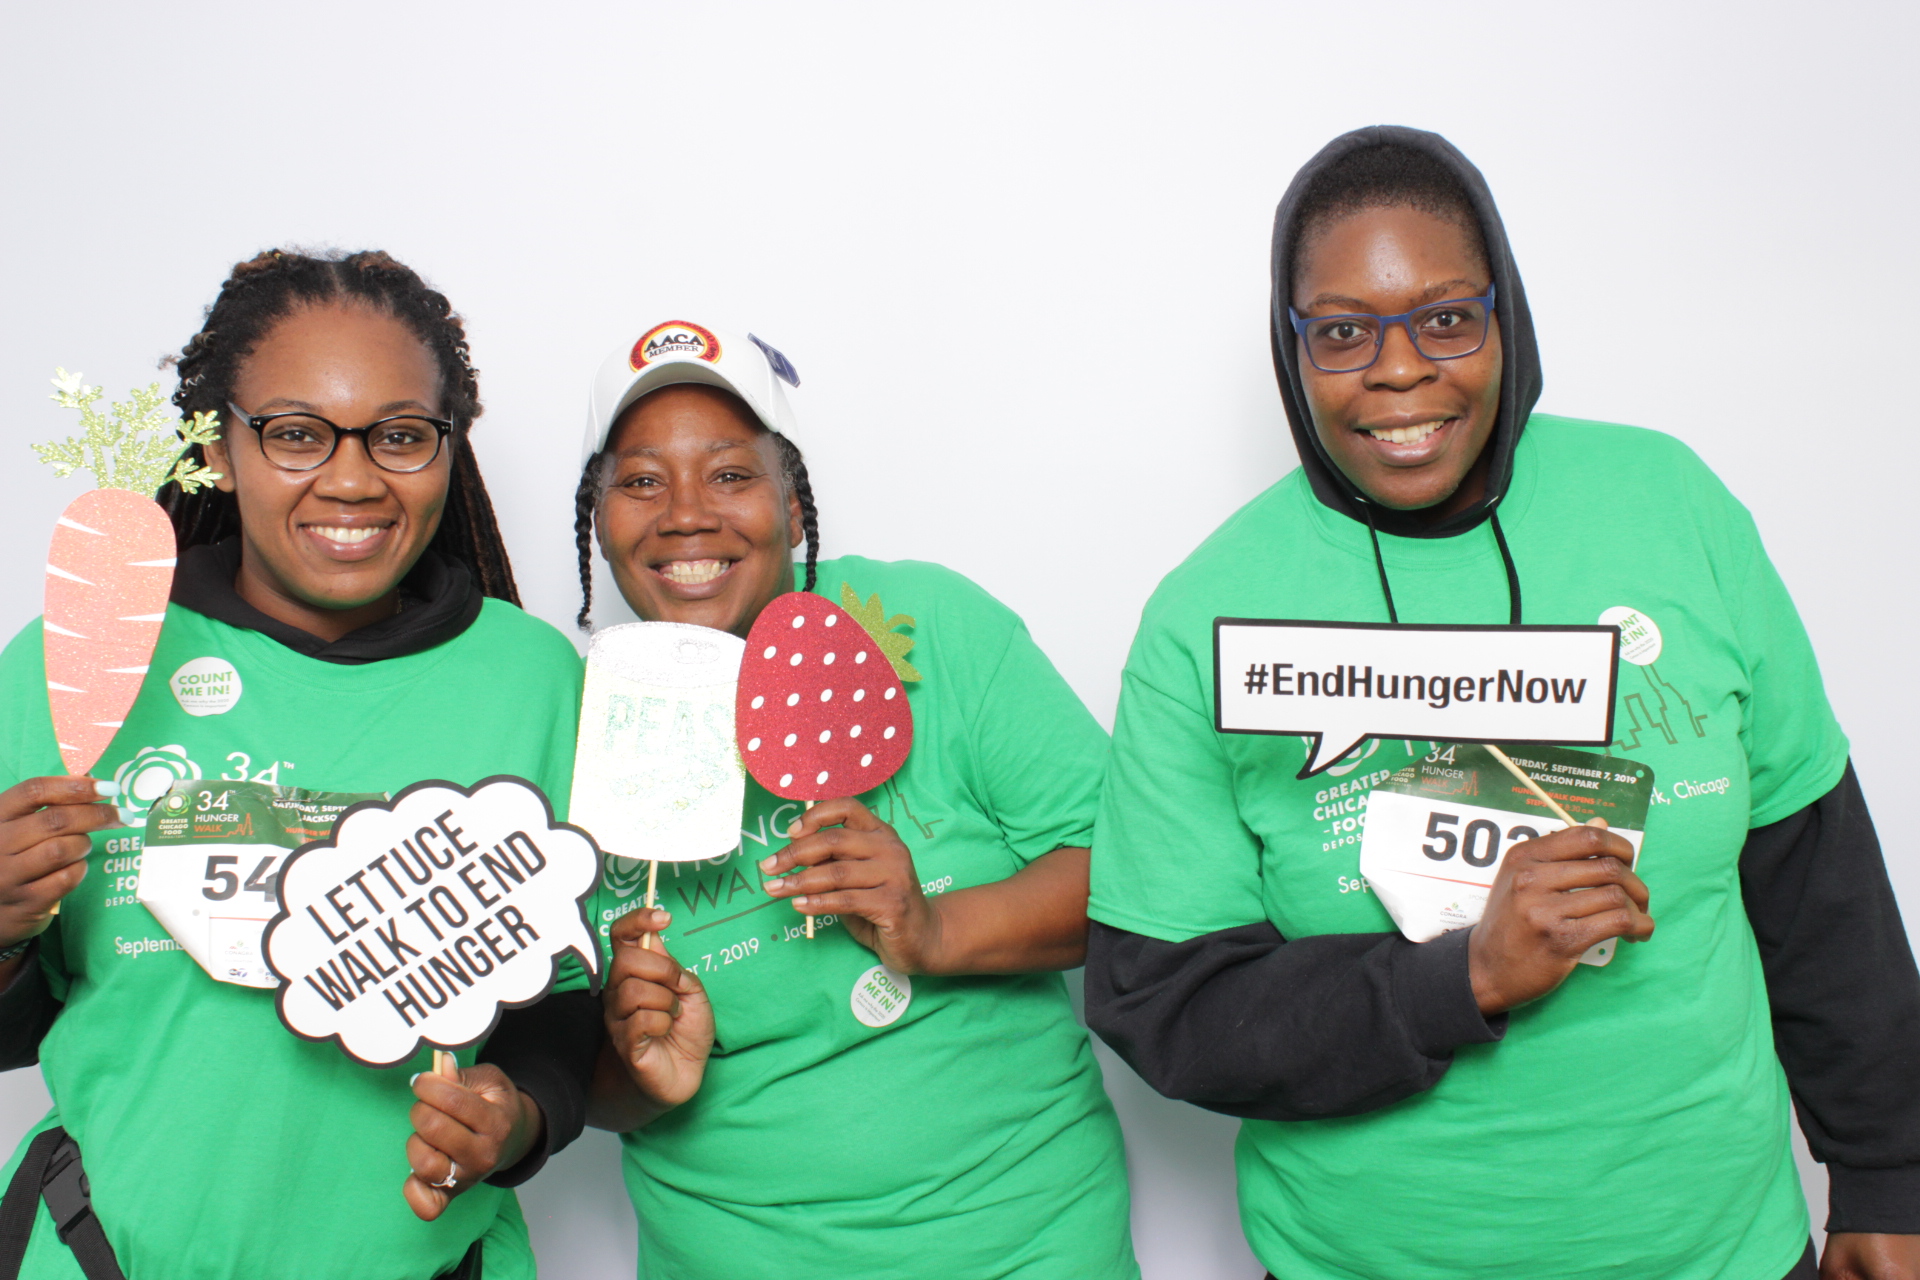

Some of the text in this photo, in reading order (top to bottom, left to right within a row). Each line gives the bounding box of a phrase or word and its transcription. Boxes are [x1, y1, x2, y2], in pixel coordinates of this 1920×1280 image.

[644, 333, 705, 353] AACA
[649, 344, 699, 358] MEMBER
[1619, 613, 1640, 632] UNT
[178, 670, 233, 685] COUNT
[1244, 662, 1587, 709] #EndHungerNow
[180, 684, 231, 697] ME IN!
[603, 693, 733, 757] PEAS
[1421, 765, 1465, 780] HUNGER
[1499, 757, 1549, 772] TURDAY,
[1551, 763, 1602, 779] SEPTEMBER
[1614, 773, 1638, 785] 2019
[1528, 771, 1600, 790] JACKSON PARK
[1421, 776, 1450, 788] WALK
[1650, 777, 1730, 806] rk, Chicago
[1511, 785, 1536, 796] HUNG
[1569, 795, 1595, 805] OPENS
[195, 813, 240, 823] HUNGER
[1313, 794, 1369, 822] CHICA
[194, 824, 223, 833] WALK
[302, 814, 338, 824] JACKSO
[104, 855, 143, 874] CHIC
[306, 809, 479, 945] LETTUCE
[304, 830, 547, 1012] WALK TO END
[719, 937, 760, 965] 2019
[921, 875, 953, 895] cago
[115, 936, 185, 959] Septem
[382, 905, 541, 1028] HUNGER
[863, 981, 882, 999] ME
[878, 995, 896, 1013] IN!
[872, 970, 907, 1004] COUNT
